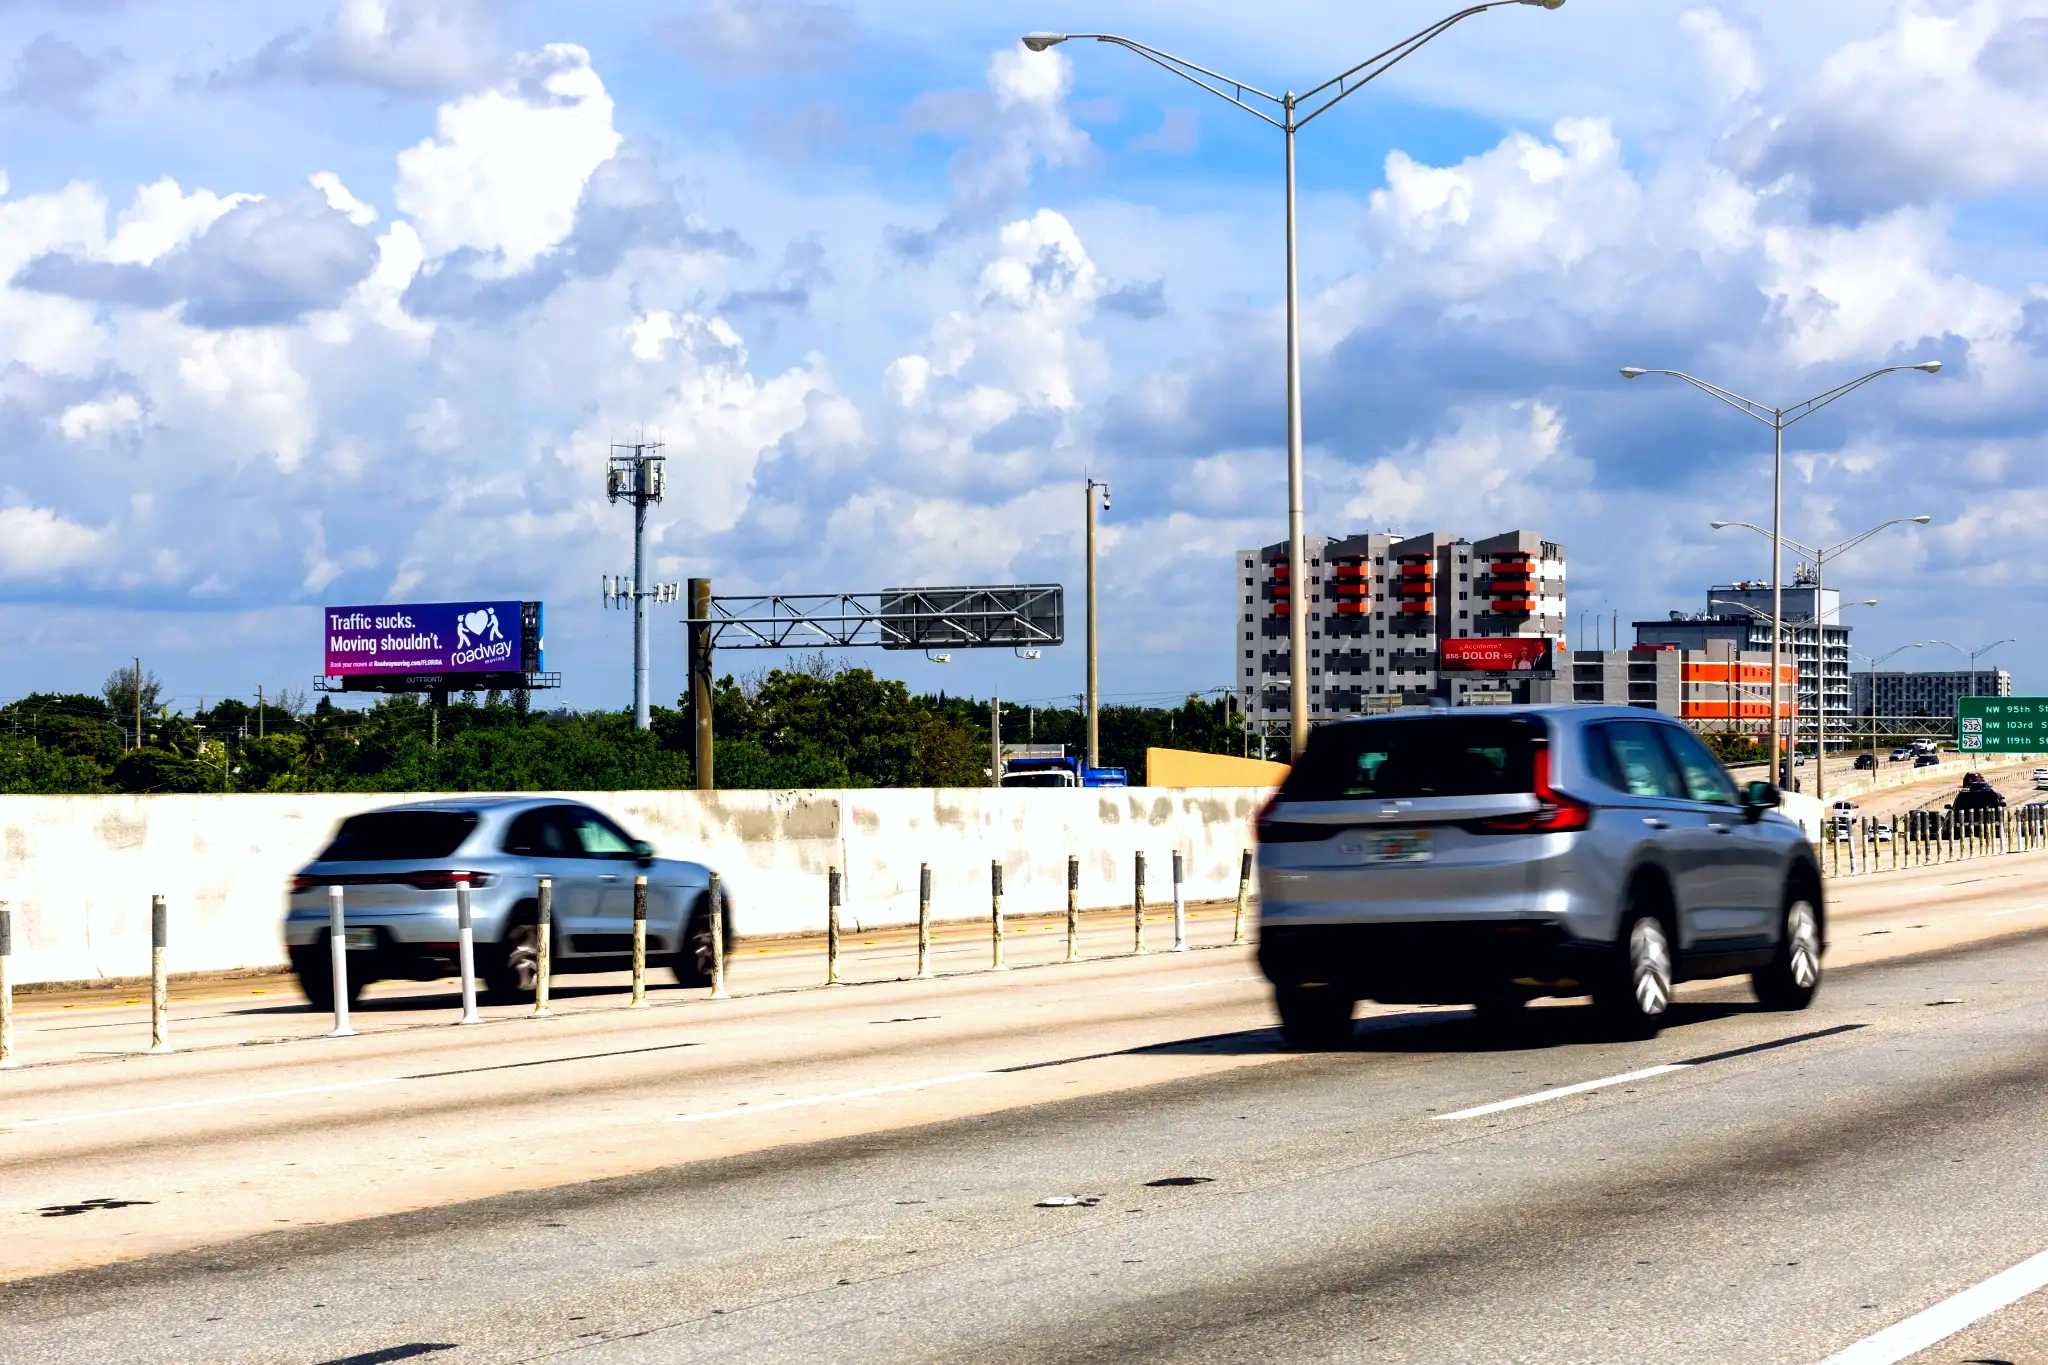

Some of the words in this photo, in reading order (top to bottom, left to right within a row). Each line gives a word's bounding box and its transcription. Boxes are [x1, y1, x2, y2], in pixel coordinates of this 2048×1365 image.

[330, 613, 371, 630] Traffic
[375, 611, 416, 629] sucks.
[330, 634, 377, 655] Moving
[380, 632, 443, 651] shouldn't.
[451, 640, 512, 666] roadway
[1985, 705, 2000, 713] NW
[2007, 705, 2031, 713] 95th
[1963, 723, 1979, 731] 932
[2007, 721, 2033, 729] 103rd
[2041, 721, 2048, 729] S
[1963, 739, 1979, 747] 924
[1985, 737, 2000, 745] NW
[2007, 737, 2031, 745] 119th
